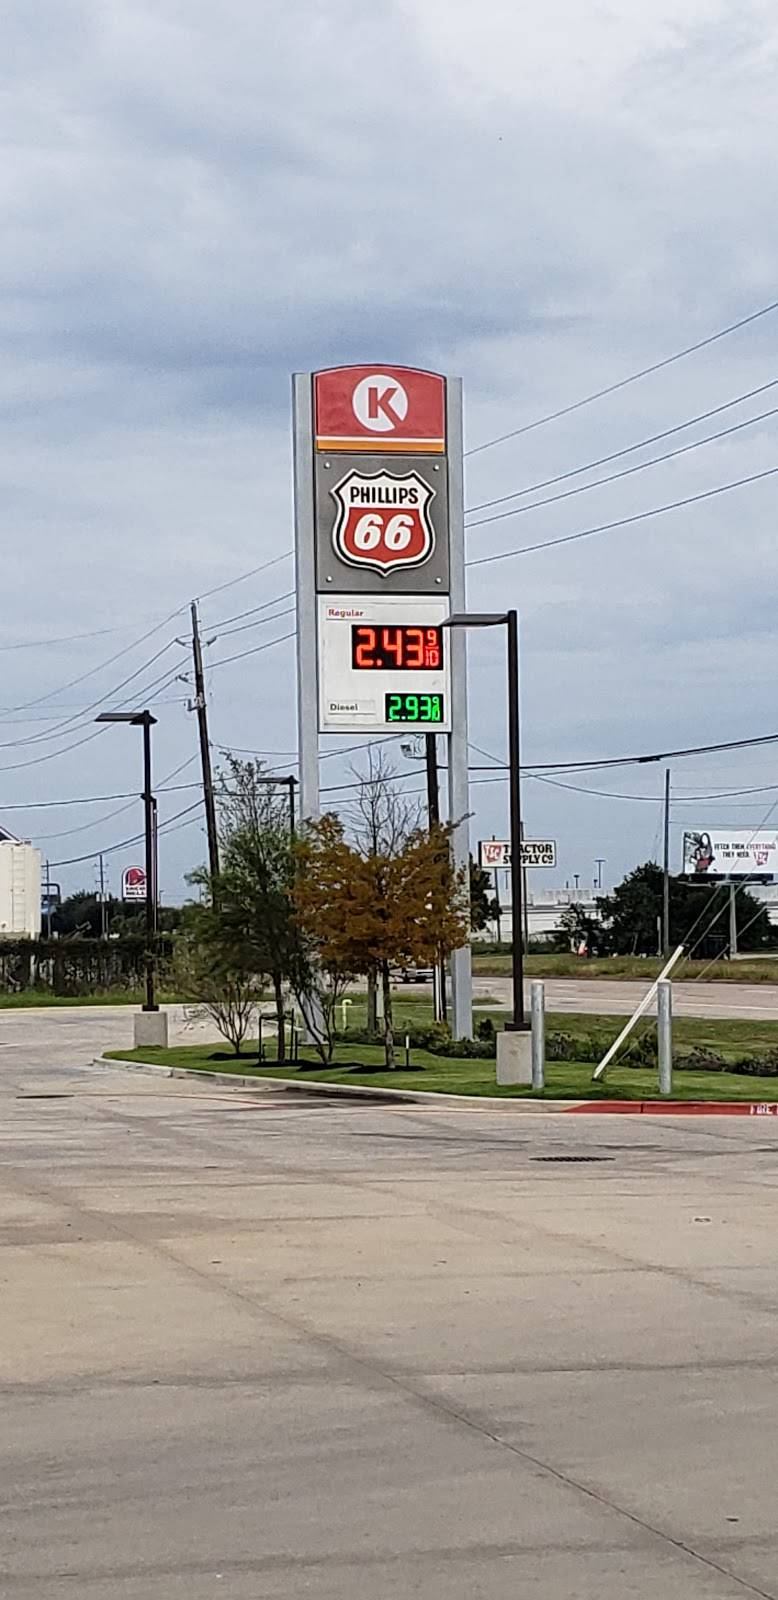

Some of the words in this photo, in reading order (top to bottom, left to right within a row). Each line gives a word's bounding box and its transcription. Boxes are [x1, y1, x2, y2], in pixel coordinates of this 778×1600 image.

[368, 387, 405, 430] K
[350, 486, 419, 504] PHILLIPS
[353, 513, 415, 551] 66
[328, 608, 364, 618] Regular
[329, 703, 359, 711] Diesel
[503, 844, 553, 854] TACTOR
[503, 855, 540, 864] SPLY
